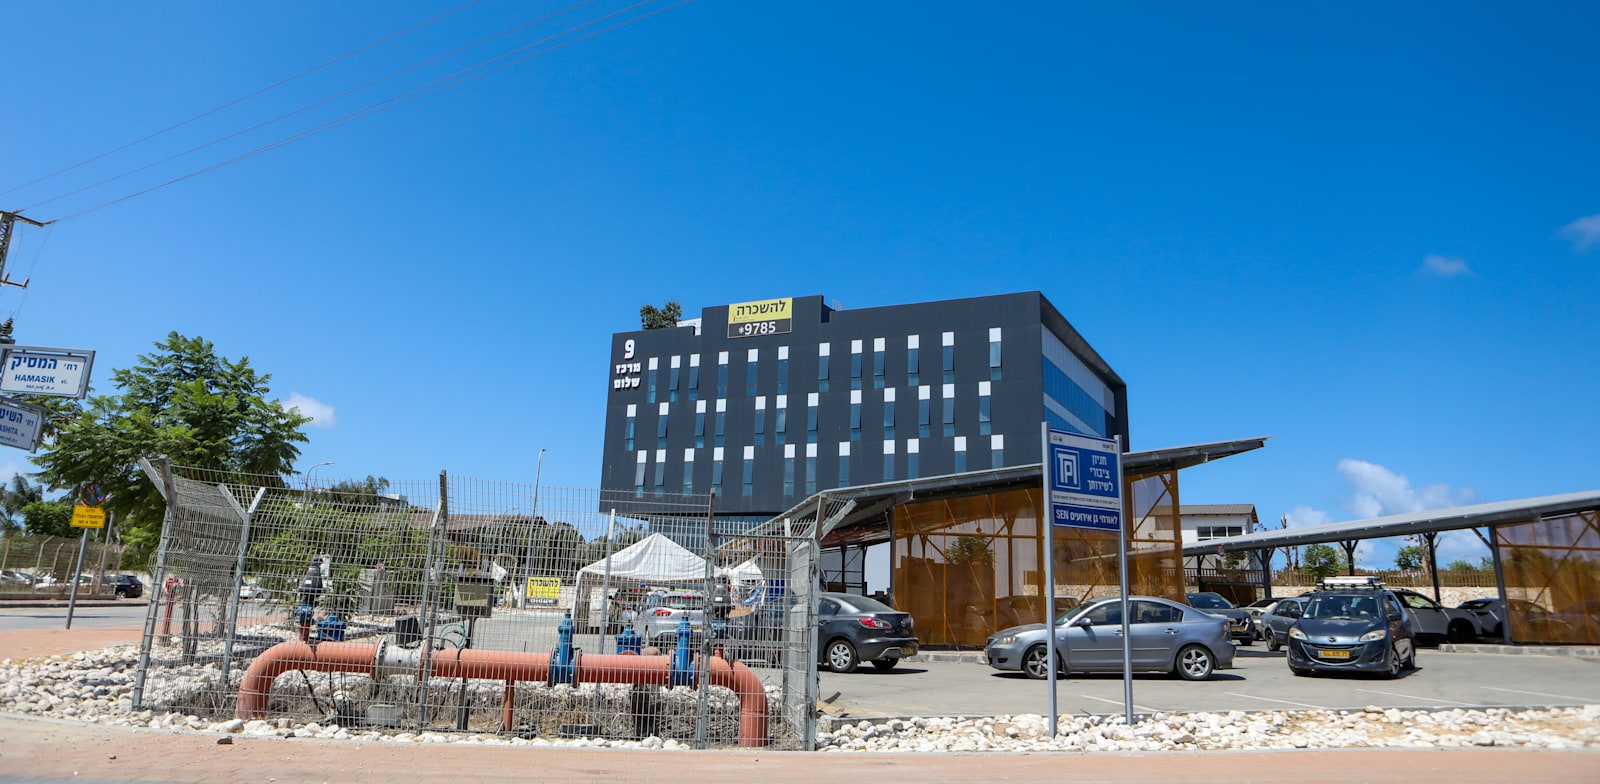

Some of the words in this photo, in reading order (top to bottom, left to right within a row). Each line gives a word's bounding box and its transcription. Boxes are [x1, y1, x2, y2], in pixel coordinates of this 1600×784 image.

[737, 299, 786, 316] להשכרה
[624, 339, 635, 359] 9
[11, 356, 57, 370] המסיק
[615, 362, 641, 374] מרכז
[14, 374, 56, 384] HAMASIK
[613, 376, 640, 389] שלום
[1091, 454, 1107, 466] חניון
[1089, 467, 1110, 479] ציבורי
[1087, 479, 1114, 492] לשירותך
[1055, 508, 1069, 520] SEN
[1070, 511, 1092, 522] אירועים
